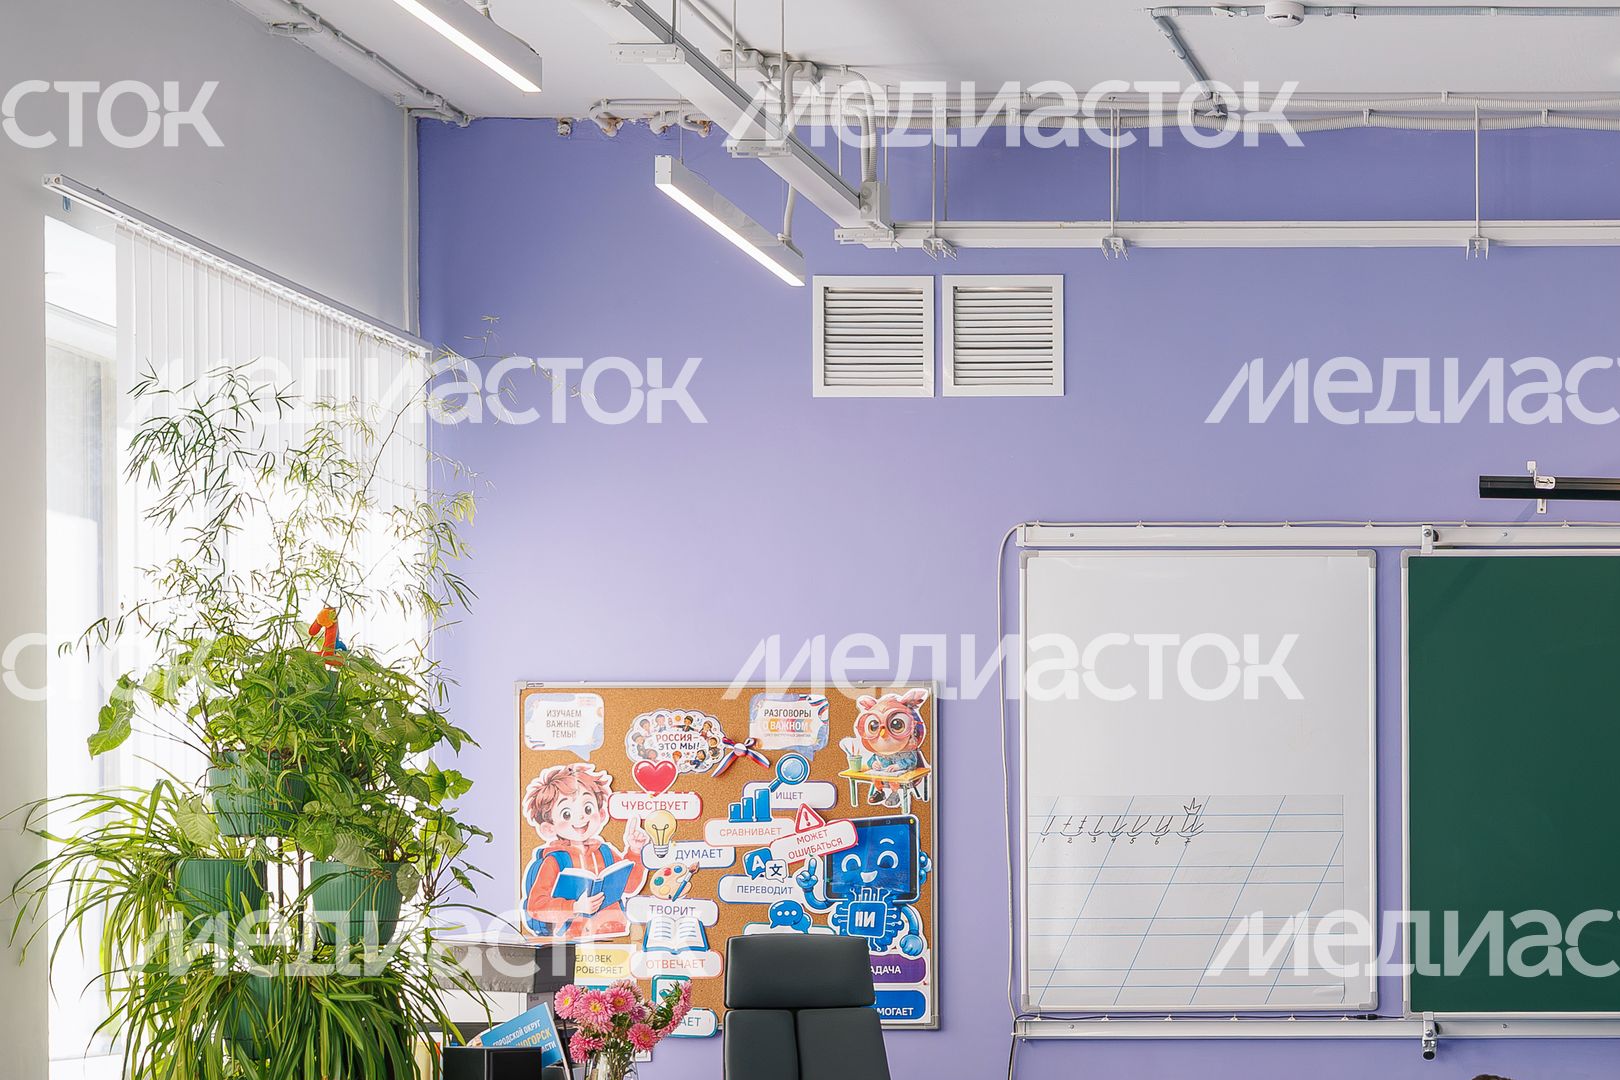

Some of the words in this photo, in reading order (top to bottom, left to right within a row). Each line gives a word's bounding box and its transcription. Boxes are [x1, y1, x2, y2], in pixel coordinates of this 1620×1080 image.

[546, 709, 582, 719] ИЗУЧАЕМ
[763, 709, 812, 718] РАЗГОВОРЫ
[546, 720, 581, 728] ВАЖНЫЕ
[770, 720, 809, 731] ВАЖНОМ
[552, 730, 577, 739] ТЕМЫ!
[658, 742, 677, 751] ЭТО
[679, 741, 700, 750] МЫ!
[775, 791, 803, 801] ИЩЕТ
[621, 800, 689, 811] ЧУВСТВУЕТ
[719, 827, 782, 837] СРАВНИВАЕТ
[796, 829, 829, 845] МОЖЕТ
[675, 848, 723, 861] ДУМАЕТ
[788, 838, 843, 860] ОШИБАТЬСЯ
[736, 884, 793, 895] ПЕРЕВОДИТ
[649, 904, 696, 916] ТВОРИТ
[576, 954, 612, 963] ЕЛОВЕК
[646, 959, 706, 970] ОТВЕЧАЕТ
[576, 966, 624, 975] РОВЕРЯЕТ
[870, 965, 902, 976] АДАЧА
[876, 1007, 914, 1016] МОГАЕТ
[523, 1019, 541, 1034] ОКРУГ
[542, 1040, 557, 1052] АСТИ
